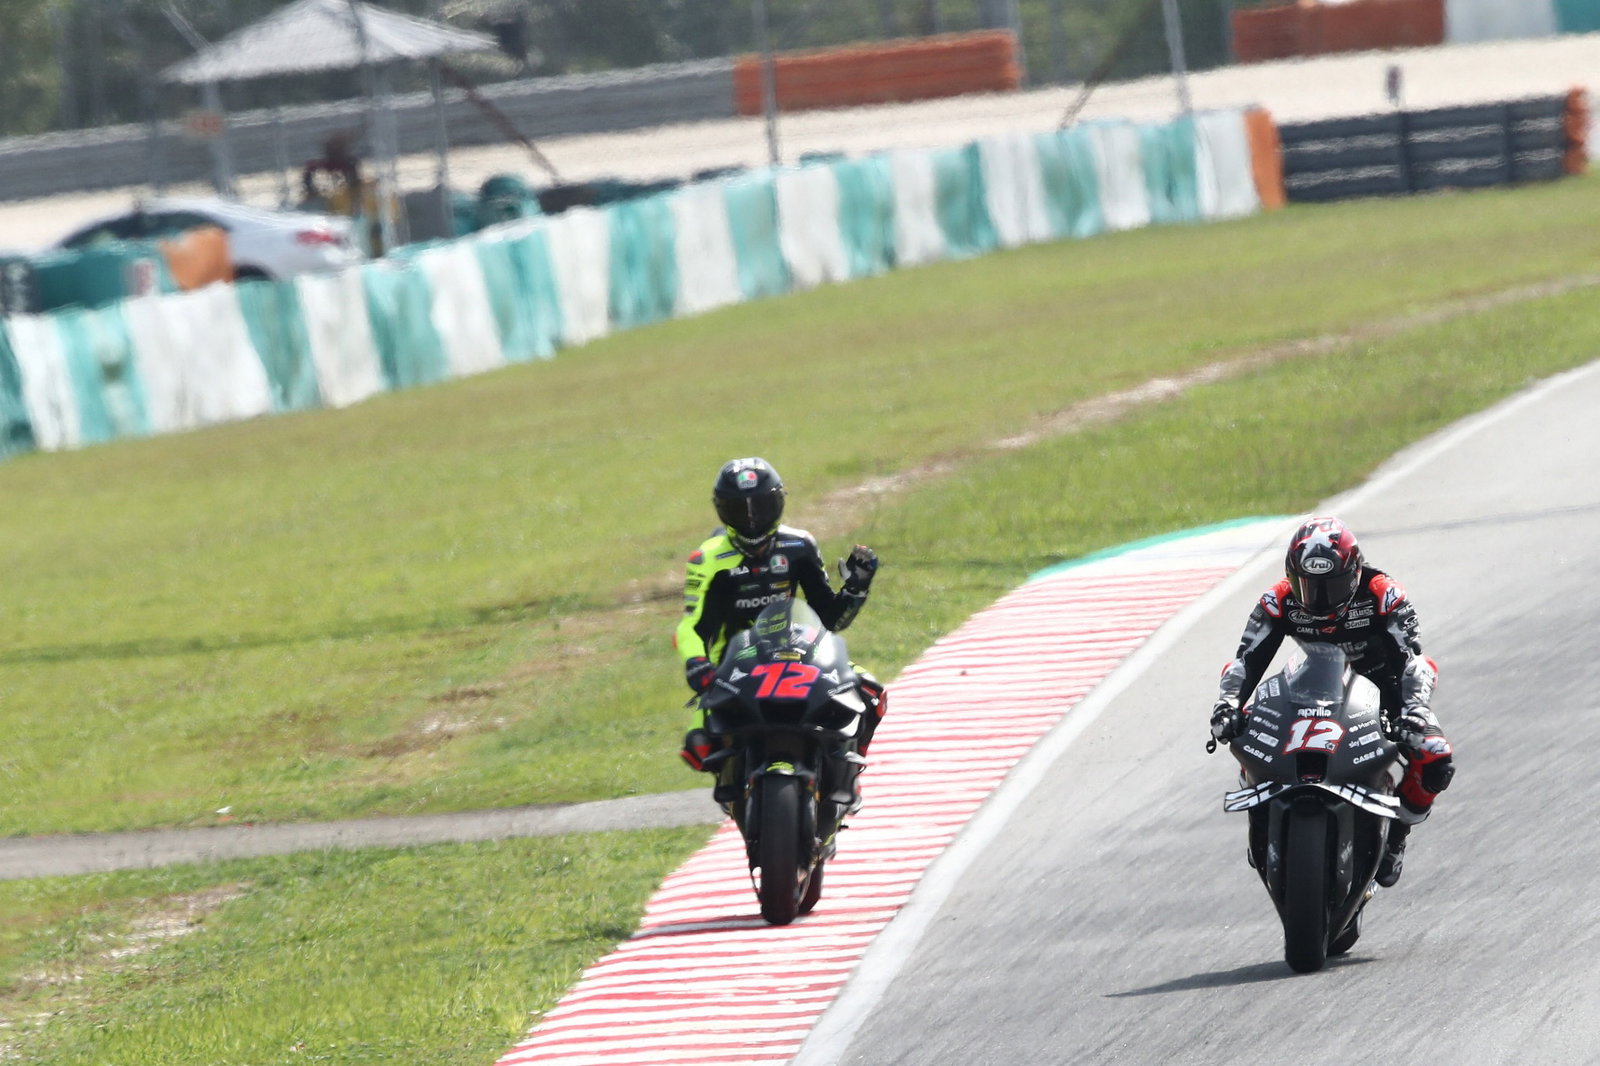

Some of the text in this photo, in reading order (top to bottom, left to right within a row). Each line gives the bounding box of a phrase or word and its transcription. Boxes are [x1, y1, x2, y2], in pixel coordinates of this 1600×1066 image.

[1304, 559, 1330, 570] Arai
[1297, 707, 1332, 718] aprilia
[1283, 718, 1346, 754] 12
[1243, 745, 1266, 760] CASE
[1353, 751, 1375, 764] CASE
